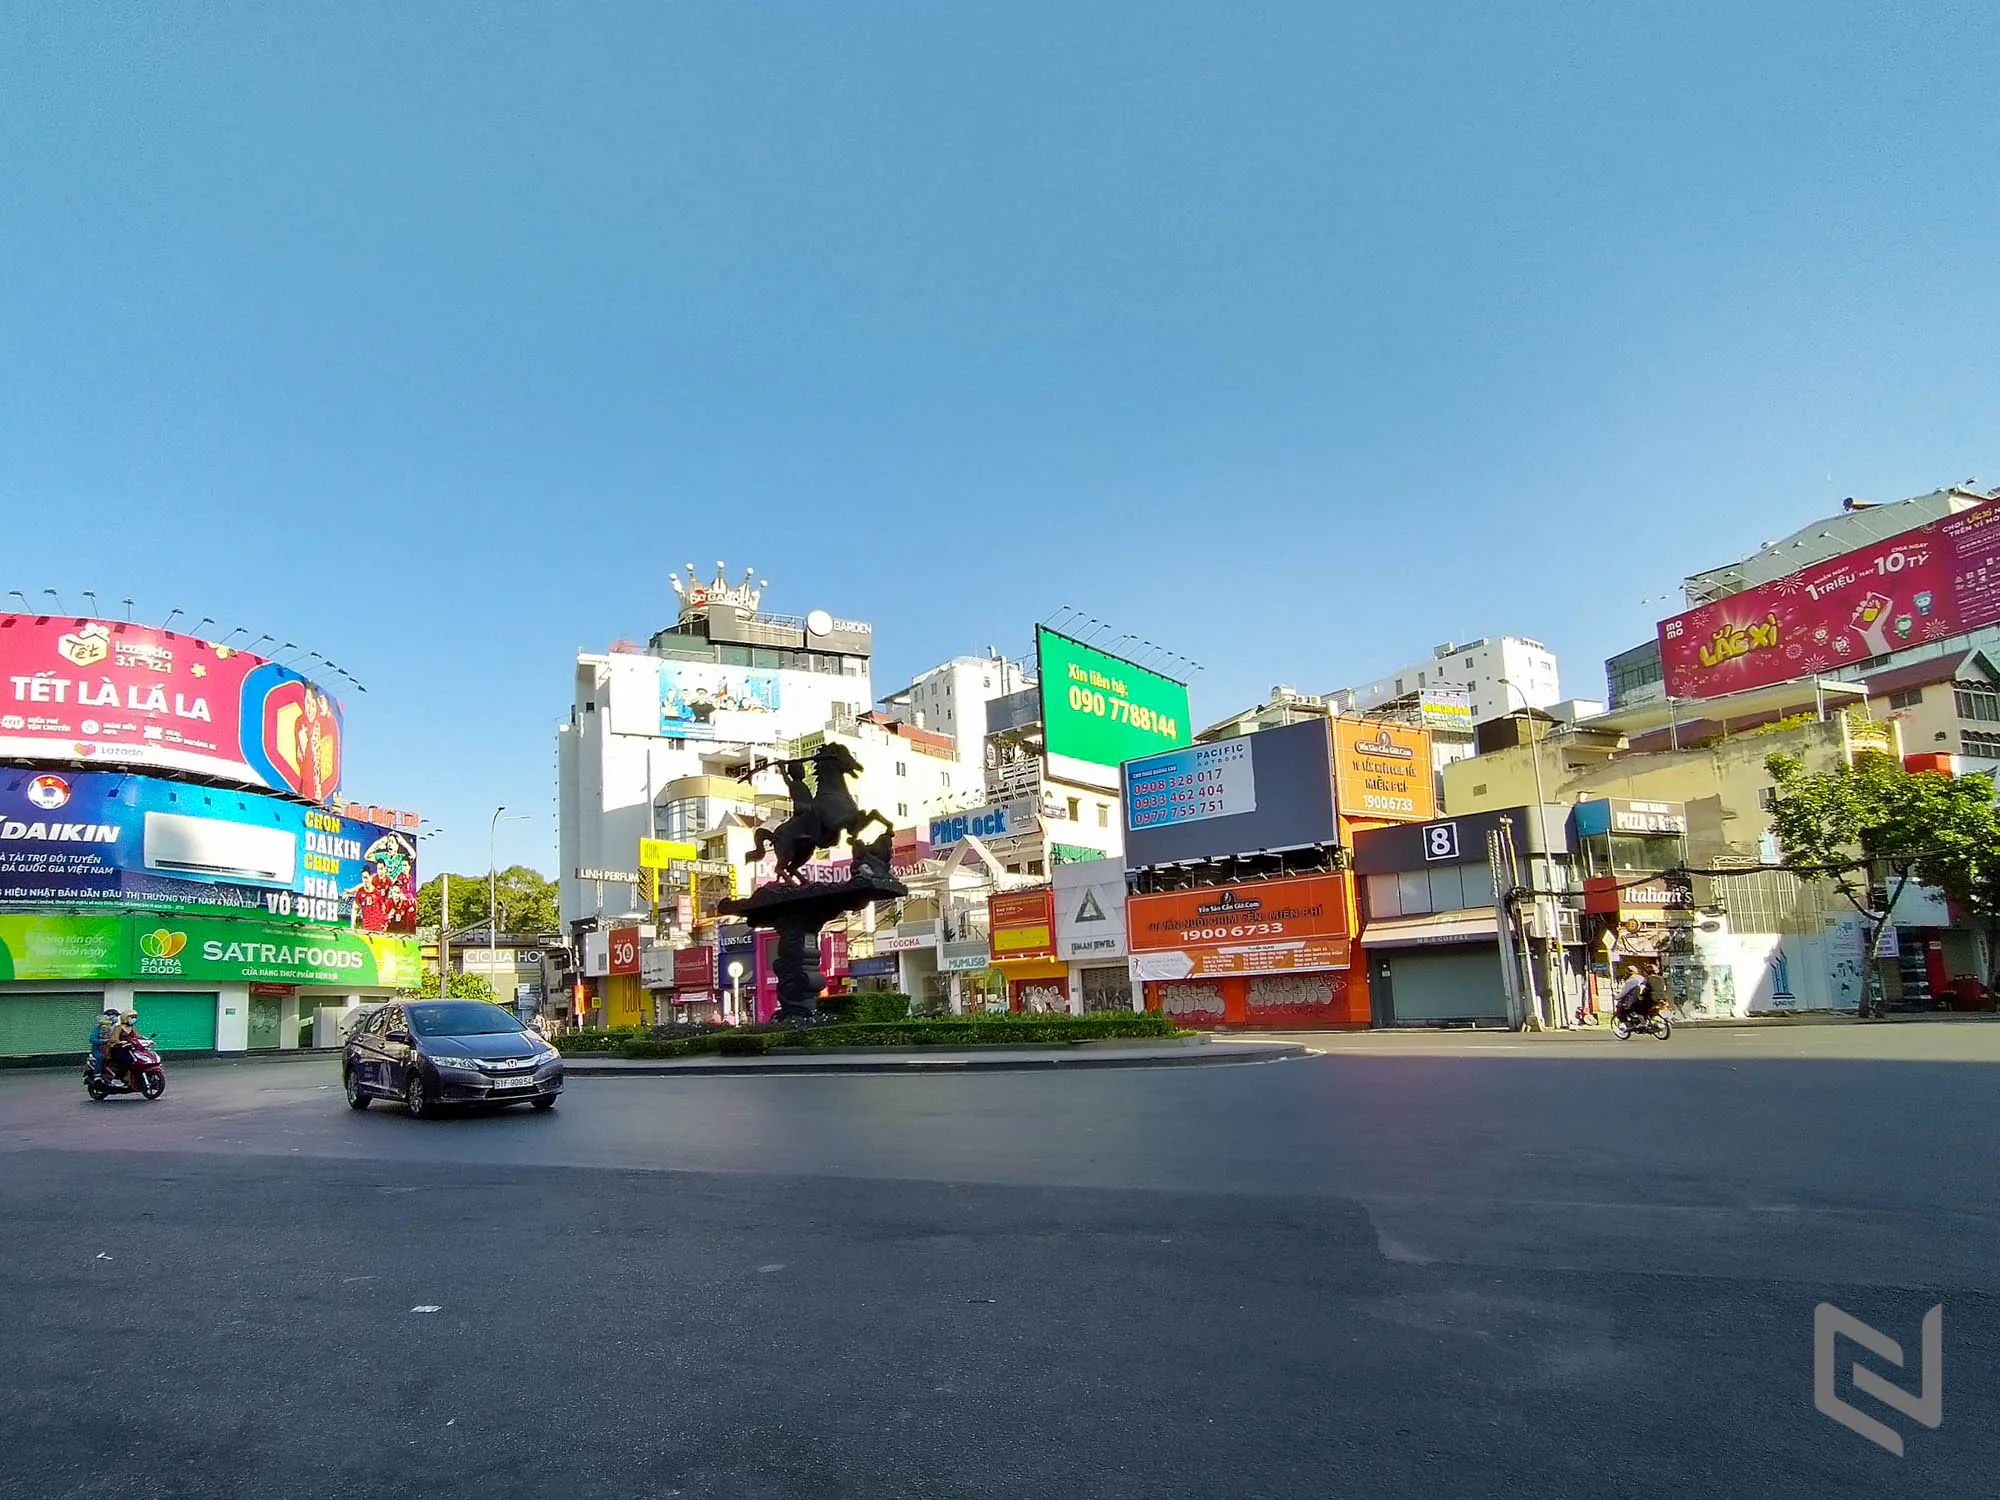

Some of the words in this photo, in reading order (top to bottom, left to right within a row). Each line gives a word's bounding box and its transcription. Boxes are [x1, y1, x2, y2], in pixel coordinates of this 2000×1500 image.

[1949, 525, 1972, 537] TRÊN
[1805, 584, 1819, 601] 1
[1817, 573, 1855, 595] TRIỆU
[1859, 568, 1875, 577] HAY
[1874, 552, 1905, 575] 10
[1832, 566, 1849, 576] NGAY
[66, 639, 100, 659] Tết
[1068, 662, 1089, 683] Xin
[1090, 669, 1111, 691] liên
[10, 671, 71, 703] TẾT
[78, 676, 120, 707] LÀ
[128, 684, 169, 713] LÁ
[175, 693, 211, 722] LA
[1069, 685, 1105, 717] 090
[1109, 696, 1178, 740] 7788144
[100, 745, 144, 757] Lazada
[1196, 743, 1244, 760] PACIFIC
[1196, 754, 1244, 767] OUTDOOR
[1134, 780, 1165, 796] 0908
[1169, 774, 1194, 788] 328
[1197, 768, 1222, 782] 017
[1135, 795, 1167, 811] 0933
[1170, 789, 1195, 803] 462
[1198, 784, 1224, 798] 404
[1389, 797, 1414, 811] 6733
[305, 811, 341, 833] CHỌN
[1136, 810, 1168, 825] 0977
[1171, 804, 1196, 818] 755
[1200, 799, 1224, 814] 751
[1, 821, 121, 843] DAIKIN
[1430, 827, 1450, 856] 8
[304, 830, 361, 861] DAIKIN
[8, 852, 24, 862] TÀI
[27, 853, 47, 863] TRỢ
[49, 851, 67, 863] ĐỘI
[69, 853, 102, 864] TUYỂN
[304, 853, 340, 874] CHỌN
[1, 863, 15, 872] ĐÁ
[17, 863, 46, 874] QUỐC
[48, 865, 65, 874] GIA
[66, 864, 89, 876] VIỆT
[90, 866, 114, 875] NAM
[581, 869, 603, 880] LINH
[4, 888, 26, 897] HIỆU
[29, 888, 56, 898] NHẬT
[58, 888, 78, 898] BẢN
[80, 888, 100, 898] DẪN
[102, 889, 122, 898] ĐẦU
[125, 888, 140, 900] THỊ
[141, 891, 178, 902] TRƯỜNG
[179, 895, 197, 904] VIỆT
[303, 874, 339, 901] NHÀ
[266, 890, 290, 916] VÔ
[297, 898, 339, 924] ĐỊCH
[1180, 927, 1227, 941] 1900
[1231, 922, 1284, 937] 6733
[141, 958, 182, 967] SATRA
[203, 940, 363, 969] SATRAFOODS
[614, 942, 634, 965] 30
[948, 957, 986, 969] MUMUSO
[141, 966, 182, 974] FOODS
[241, 966, 258, 976] CỬA
[259, 968, 278, 977] HÀNG
